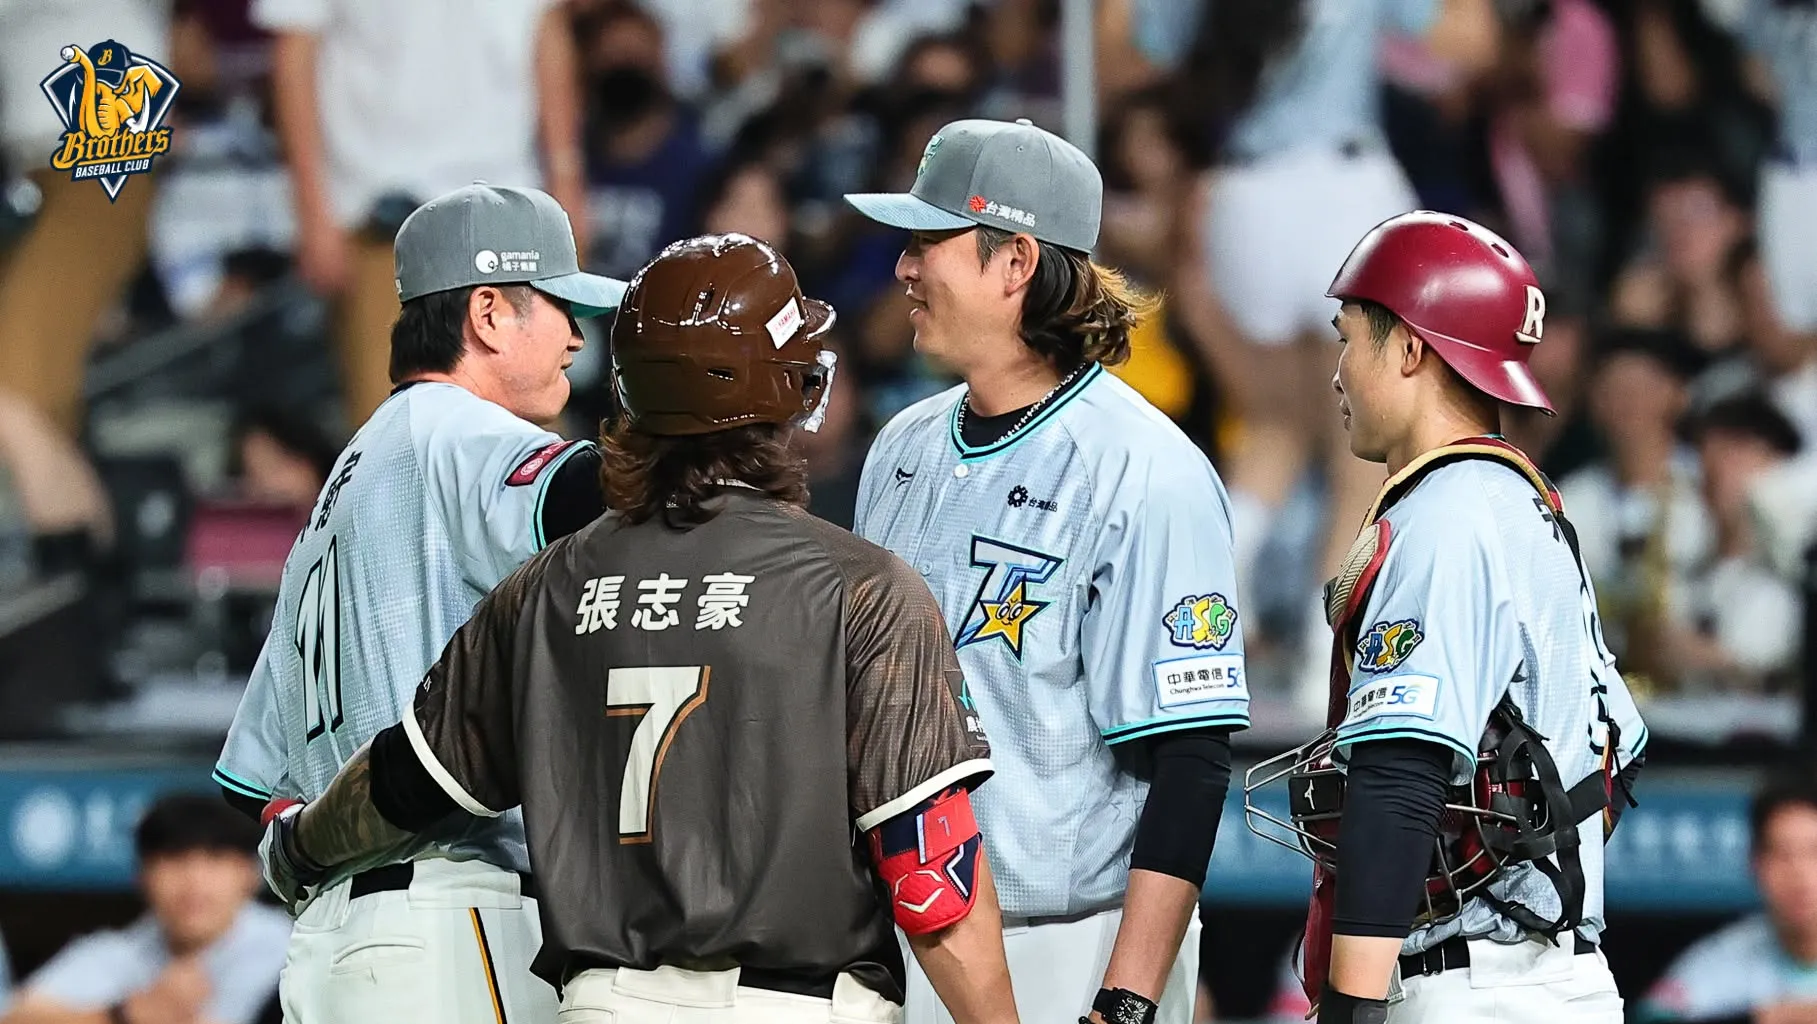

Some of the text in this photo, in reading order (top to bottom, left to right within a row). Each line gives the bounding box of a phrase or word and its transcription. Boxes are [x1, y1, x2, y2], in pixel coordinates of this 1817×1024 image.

[985, 201, 1036, 228] 台灣精品
[500, 250, 540, 261] gamania
[1514, 284, 1546, 344] R
[575, 572, 756, 635] 張志豪
[1174, 598, 1230, 643] ASG
[1363, 624, 1416, 667] ASG
[606, 665, 711, 845] 7
